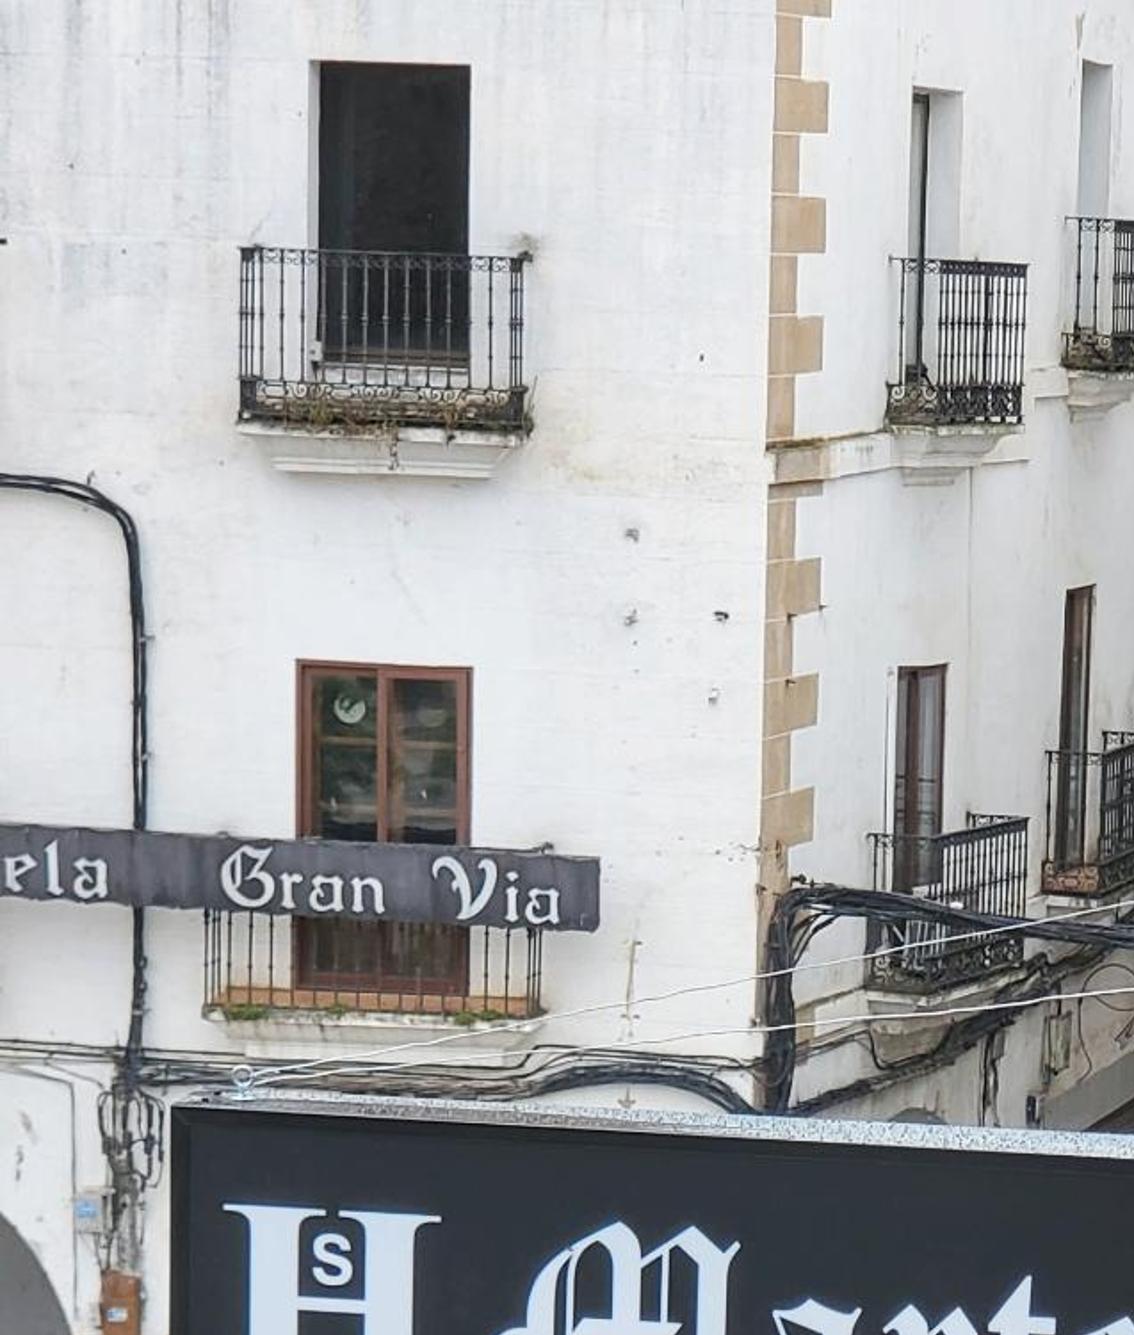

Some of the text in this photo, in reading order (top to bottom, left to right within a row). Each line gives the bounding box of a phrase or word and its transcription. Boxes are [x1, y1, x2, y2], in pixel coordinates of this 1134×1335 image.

[3, 839, 560, 925] ela Gran Via
